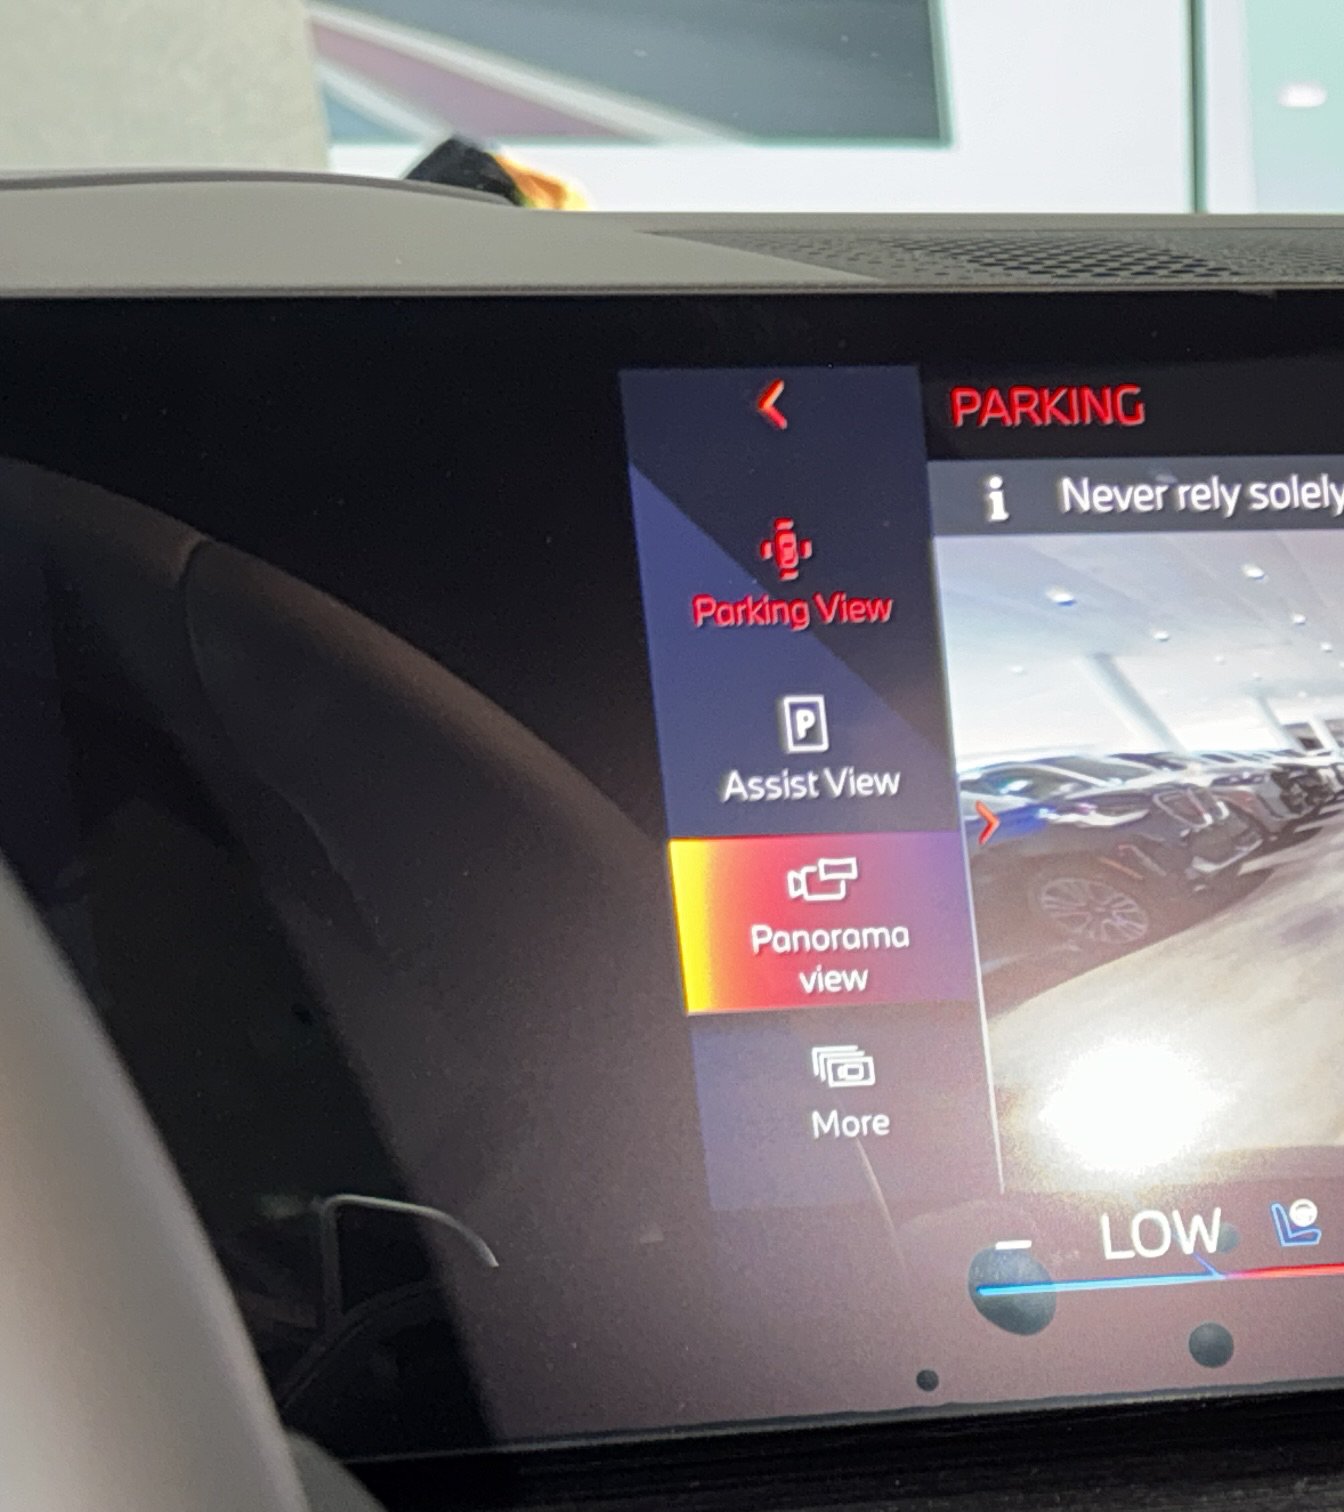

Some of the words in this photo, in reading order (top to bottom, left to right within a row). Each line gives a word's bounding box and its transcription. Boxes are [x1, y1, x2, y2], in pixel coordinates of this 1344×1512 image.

[950, 385, 1146, 427] PARKING
[1060, 477, 1166, 512] Never
[1178, 476, 1240, 518] rely
[693, 595, 809, 630] Parking
[813, 592, 893, 623] View
[723, 766, 819, 802] Assist
[824, 767, 901, 798] View
[751, 925, 910, 954] Panorama
[799, 964, 868, 994] view
[811, 1110, 890, 1139] More
[1101, 1207, 1222, 1260] LOW
